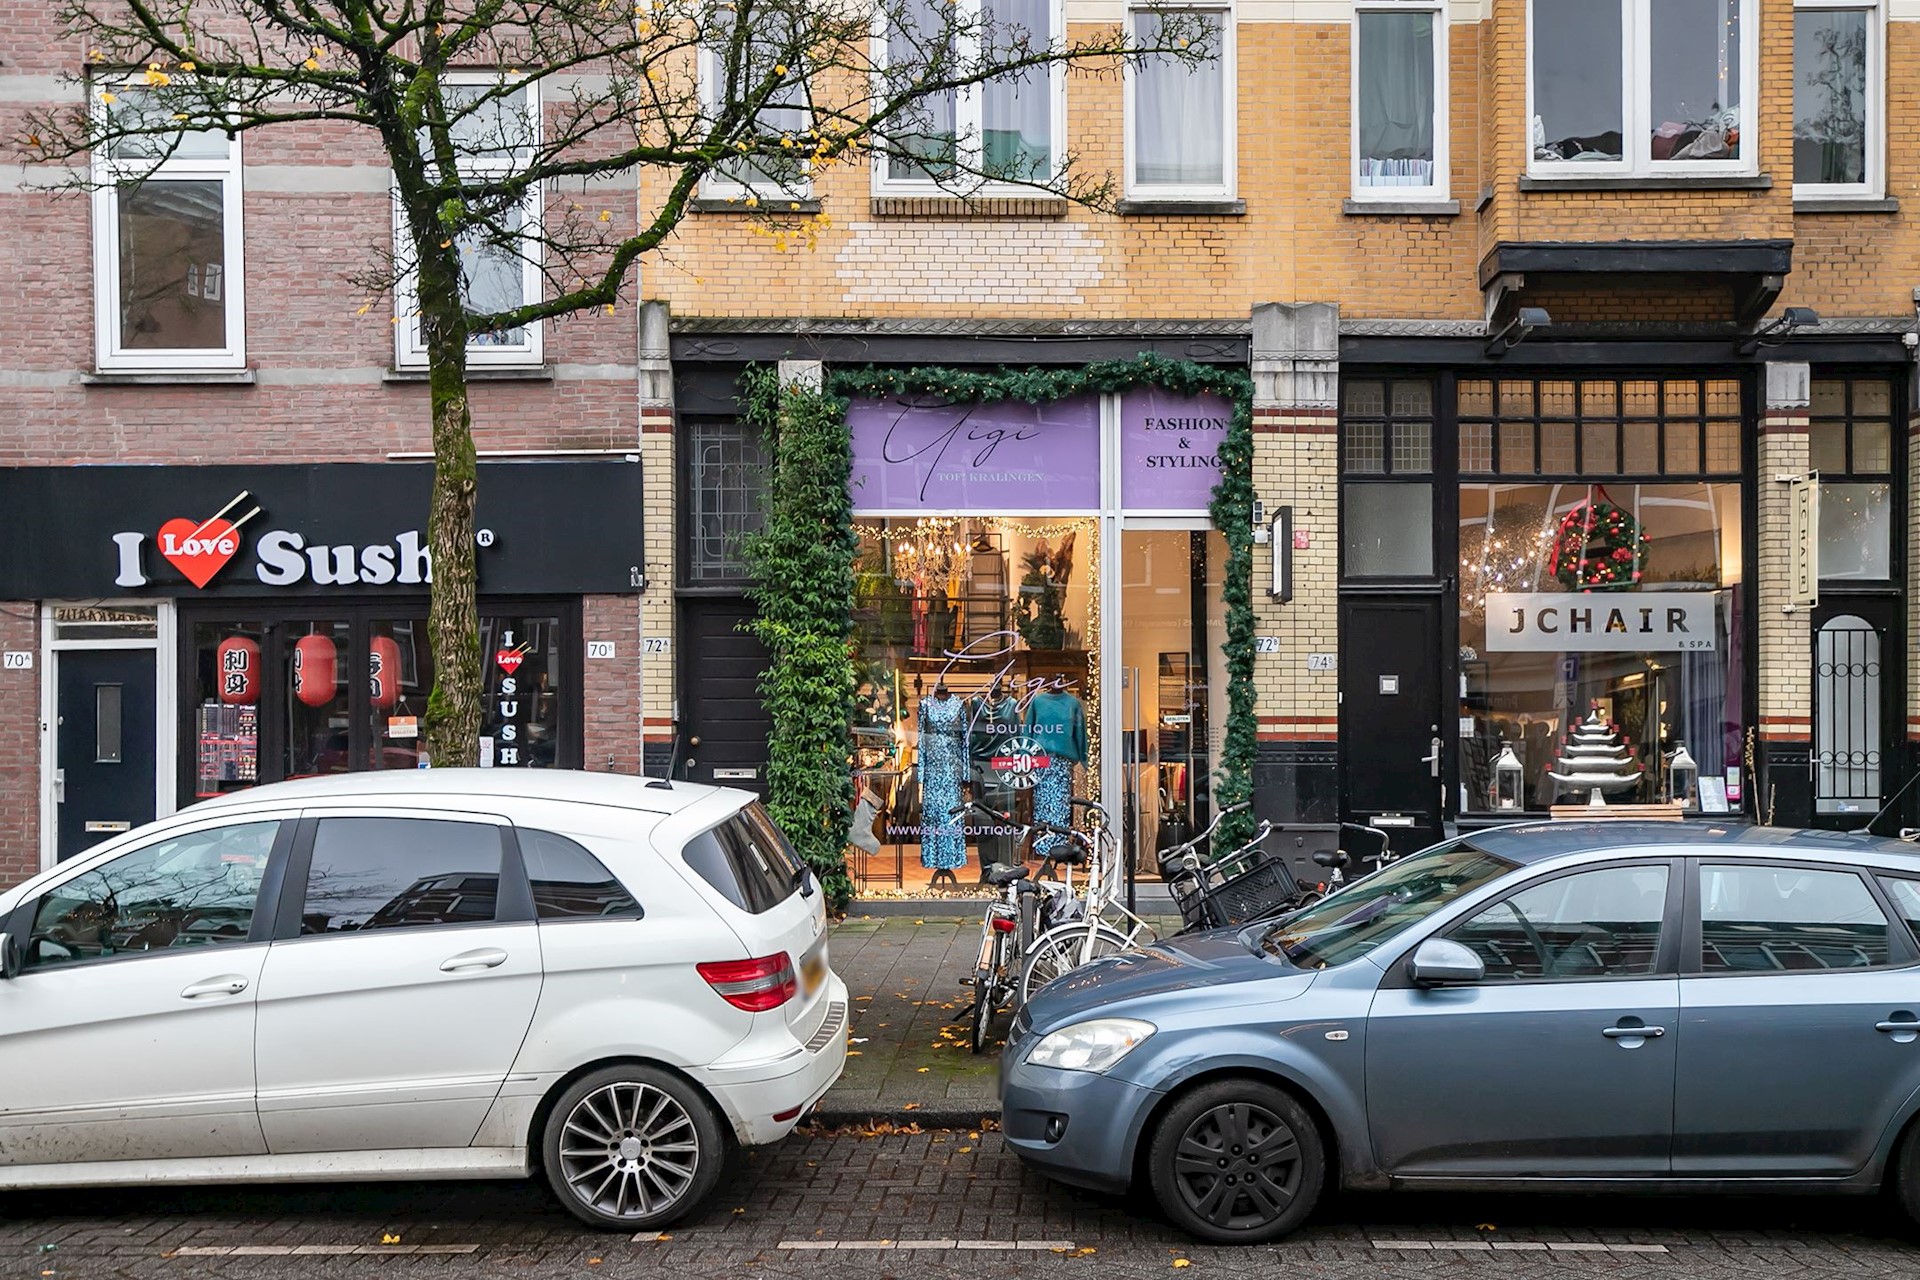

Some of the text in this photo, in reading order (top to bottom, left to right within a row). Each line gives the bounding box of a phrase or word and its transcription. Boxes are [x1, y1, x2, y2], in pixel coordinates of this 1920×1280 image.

[1144, 417, 1225, 431] FASHION
[1178, 436, 1191, 449] &
[1146, 455, 1222, 468] STYLING
[969, 472, 1045, 482] KRALINGEN
[112, 531, 147, 588] I
[162, 533, 235, 556] Love
[256, 530, 434, 586] Sush
[1508, 607, 1690, 634] JCHAIR
[1678, 640, 1712, 648] & SPA
[5, 653, 31, 667] 70A
[498, 655, 522, 665] Love
[500, 677, 518, 765] SUSH
[985, 724, 1065, 735] BOUTIQUE
[999, 738, 1041, 757] SALE
[1001, 771, 1039, 788] SALE
